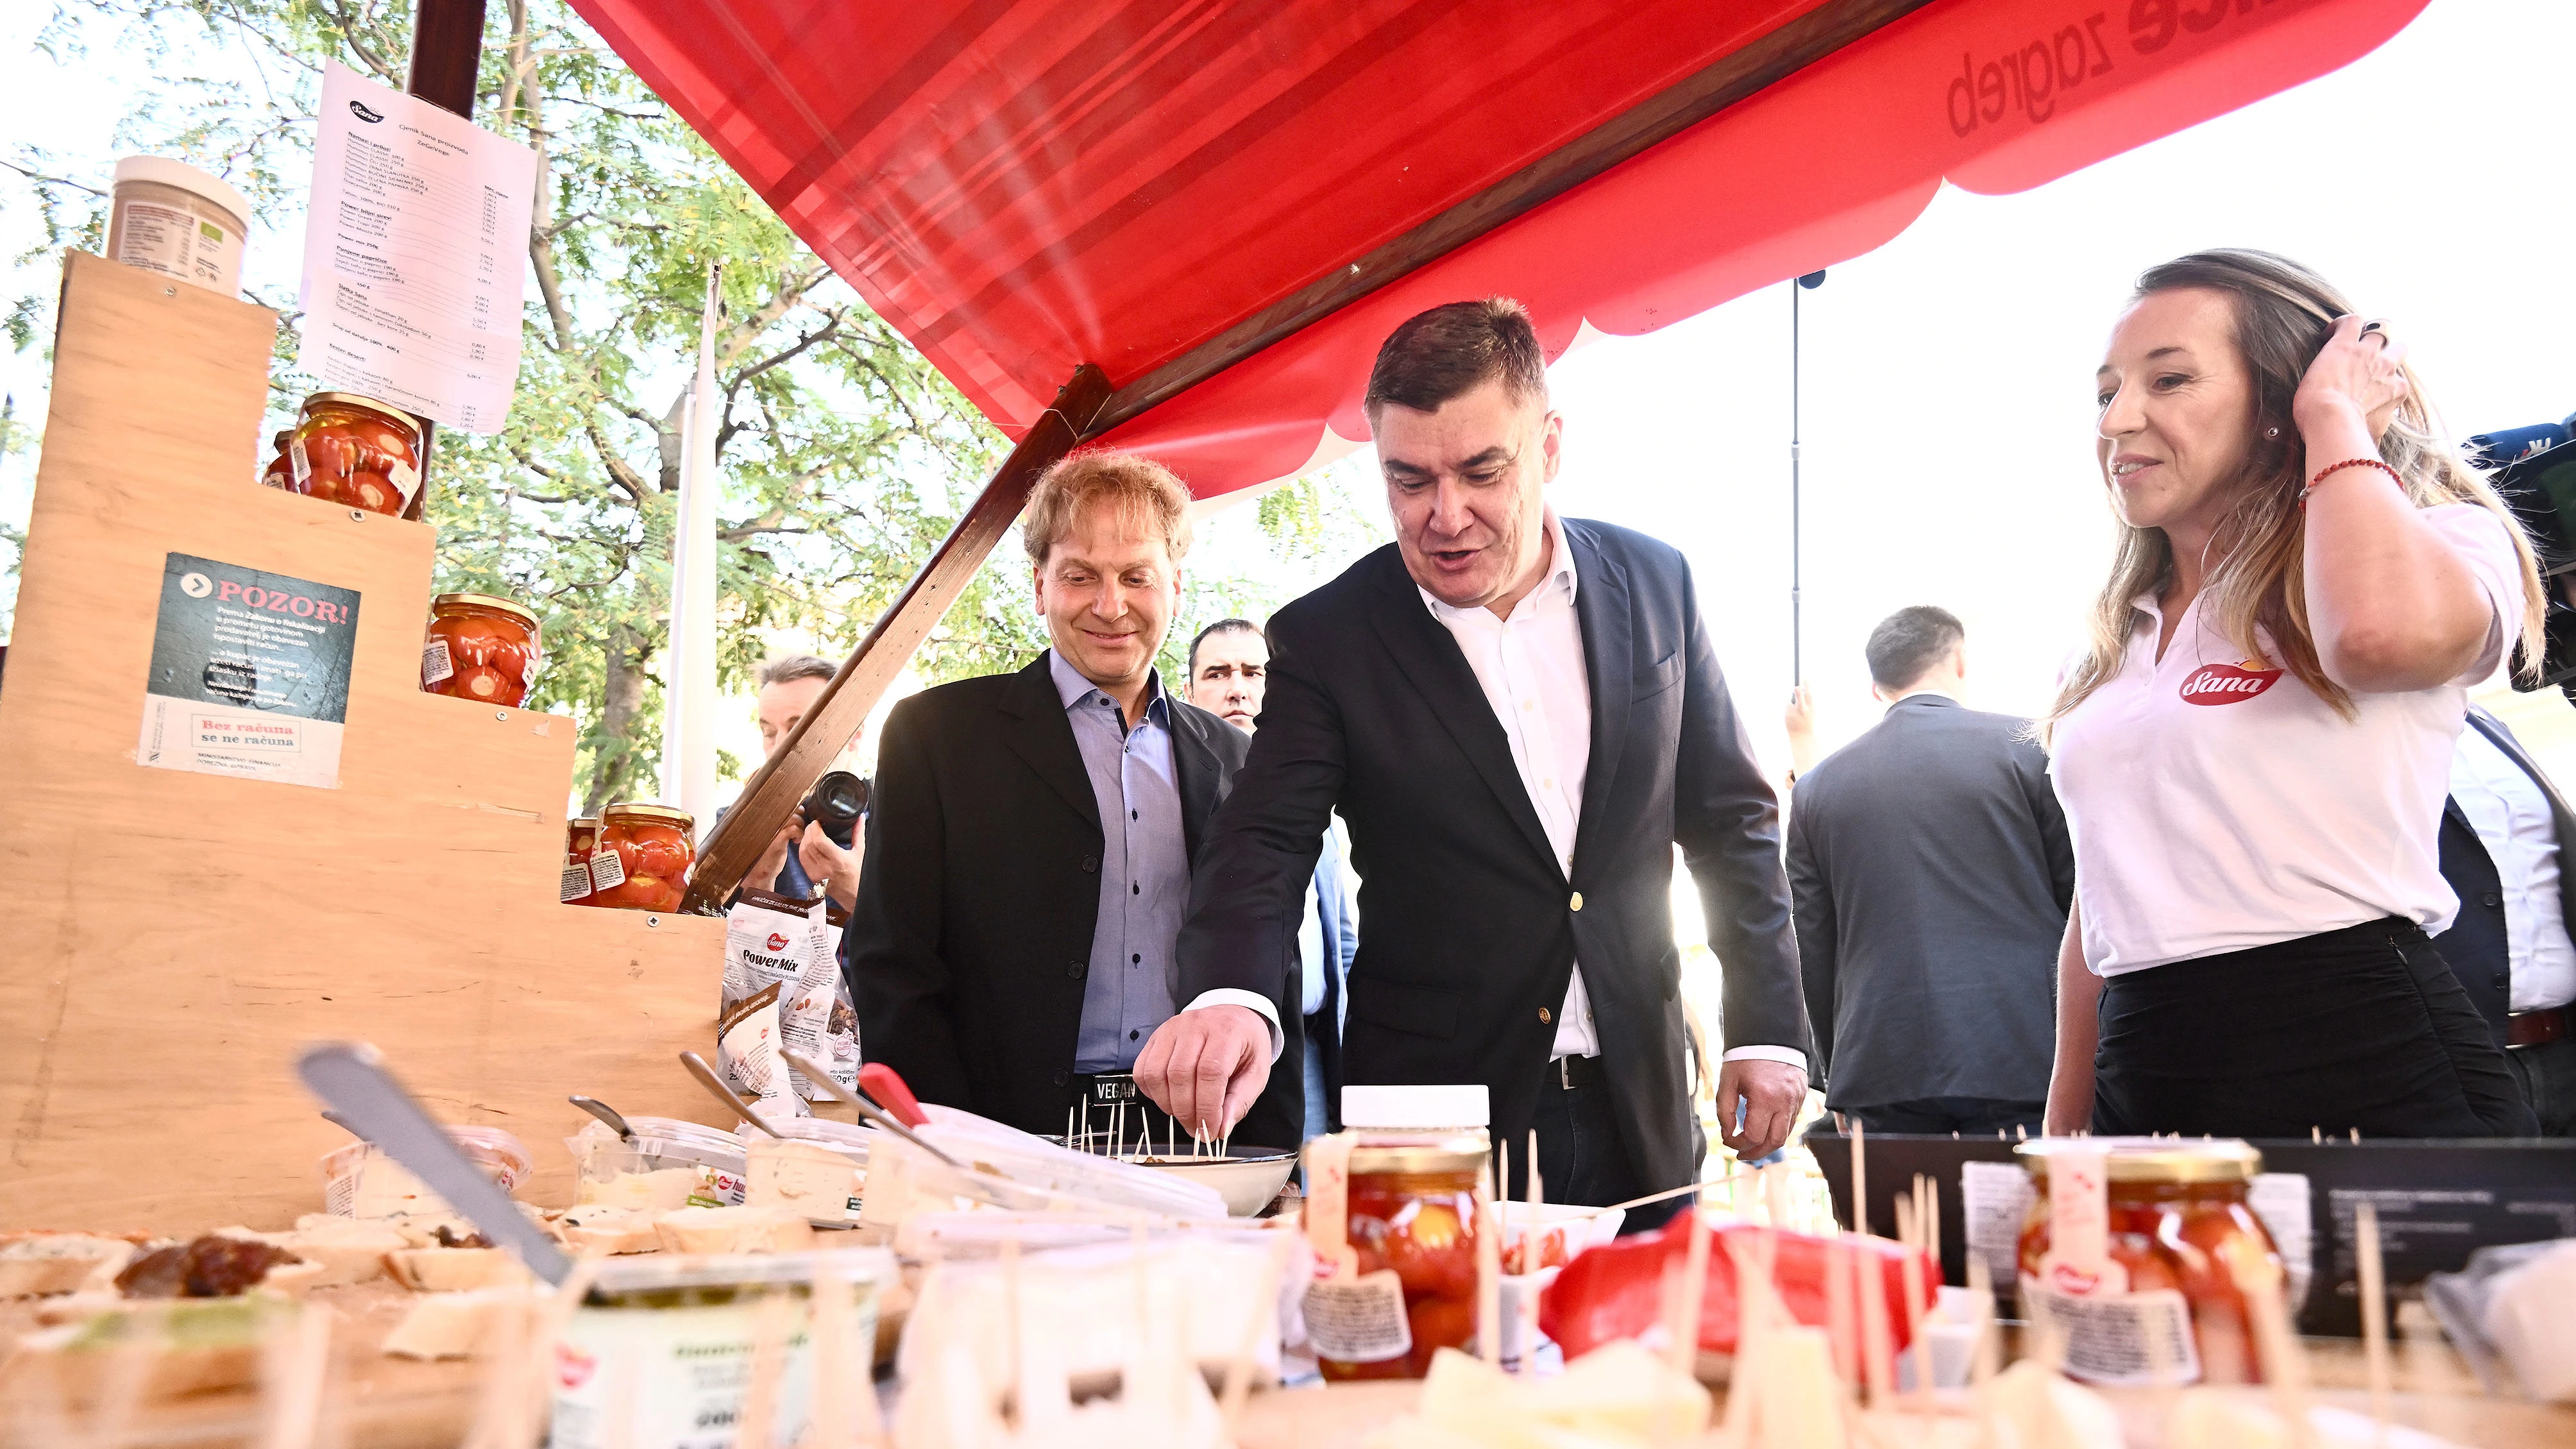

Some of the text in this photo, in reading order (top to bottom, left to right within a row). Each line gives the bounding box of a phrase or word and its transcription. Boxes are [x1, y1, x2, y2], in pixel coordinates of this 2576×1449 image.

[352, 105, 379, 122] Sana
[348, 131, 391, 152] Namazi prilozi
[399, 124, 468, 155] Cjenik Sana proizvoda
[347, 143, 368, 155] Hummus
[369, 153, 389, 163] CLASSIC
[348, 137, 369, 149] Hummus
[370, 147, 389, 157] CLASSIC
[417, 140, 450, 156] ZeGeVege
[346, 148, 368, 160] Hummus
[346, 154, 368, 166] Hummus
[344, 165, 366, 178] Hummus
[345, 160, 366, 172] Hummus
[341, 201, 359, 211] Power
[341, 207, 355, 216] Power
[339, 220, 354, 228] Power
[340, 213, 355, 222] Power
[338, 232, 353, 242] Power
[336, 251, 358, 262] Hummus
[337, 245, 360, 257] Punjene
[335, 263, 355, 273] Dimljeni
[339, 284, 367, 300] Slatka Sana
[374, 307, 396, 318] Jonathan
[373, 313, 393, 323] tamnom
[394, 321, 420, 334] čokoladom
[329, 343, 346, 353] Kesten
[362, 370, 381, 380] kakaom
[362, 376, 380, 386] kakaom
[414, 394, 429, 402] korom
[218, 581, 348, 624] POZOR!
[217, 607, 244, 617] Prema
[245, 612, 275, 623] Zakonu
[283, 619, 326, 634] fiskalizaciji
[223, 618, 258, 629] prometu
[260, 625, 303, 637] gotovinom
[215, 625, 261, 640] prodavatelj
[271, 636, 309, 647] obavezan
[226, 650, 250, 659] kupac
[262, 657, 300, 668] obavezan
[209, 665, 237, 675] izlasku
[2182, 671, 2264, 696] Sana
[201, 720, 294, 734] Bez računa
[244, 736, 294, 746] računa
[768, 936, 786, 948] Sana
[743, 949, 799, 972] Power Mix
[1097, 1083, 1135, 1099] VEGAN
